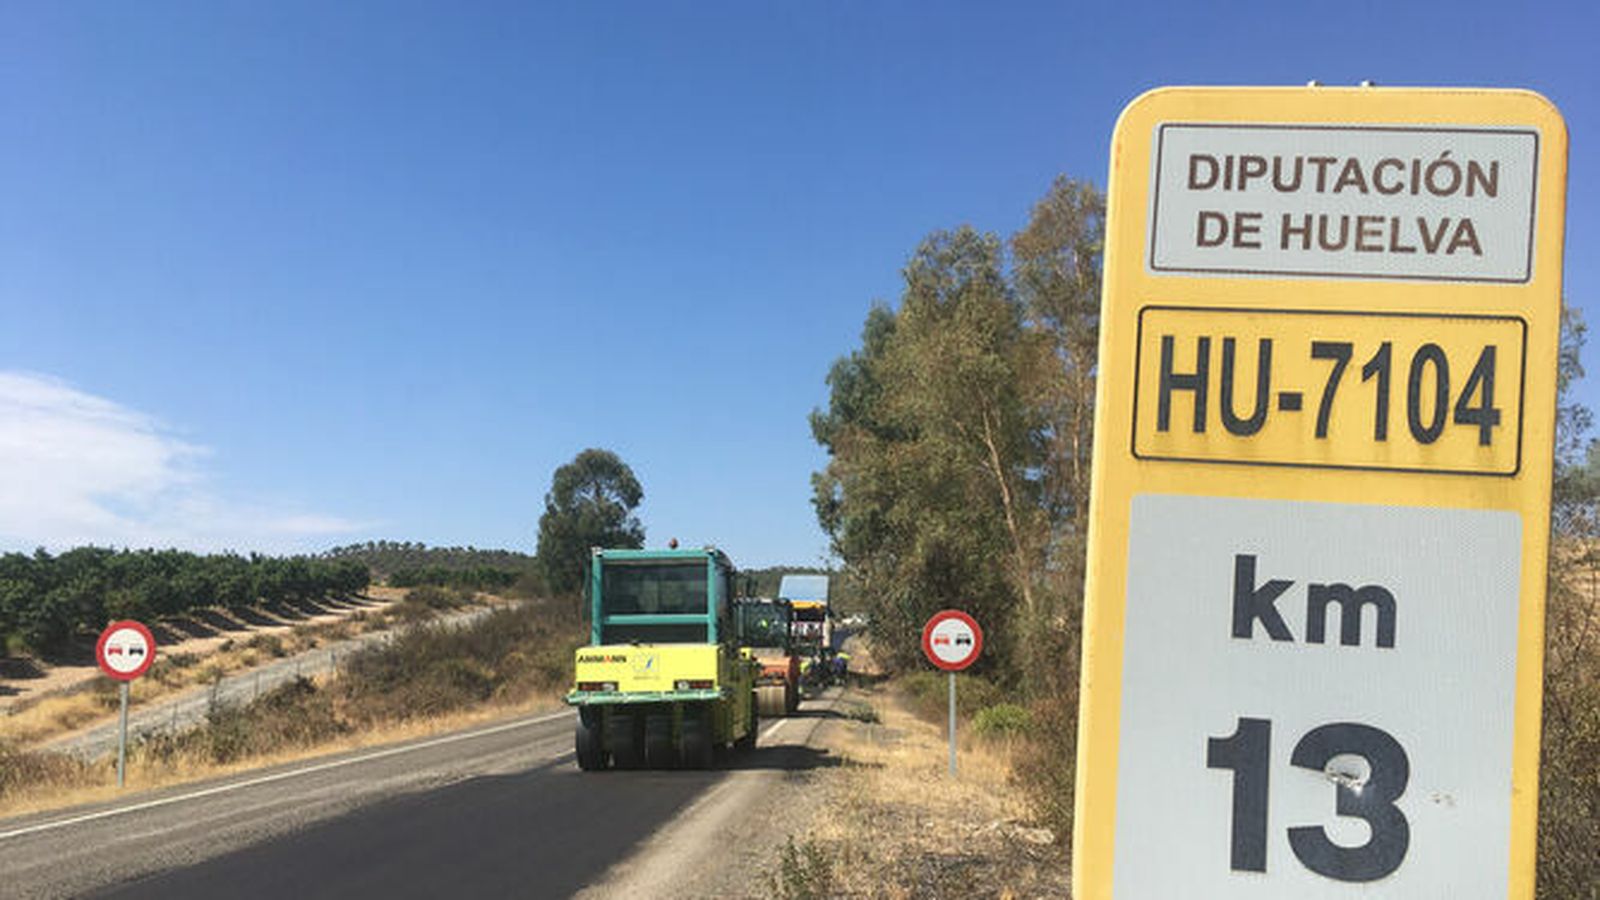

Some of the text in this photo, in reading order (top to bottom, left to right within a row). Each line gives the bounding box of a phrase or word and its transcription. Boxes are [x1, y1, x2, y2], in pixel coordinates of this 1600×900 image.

[1187, 150, 1499, 198] DIPUTACIÓN
[1196, 211, 1483, 256] DE HUELVA
[1156, 334, 1501, 447] HU-7104
[1231, 553, 1397, 649] km
[578, 654, 627, 663] AMMANN
[1206, 716, 1410, 884] 13
